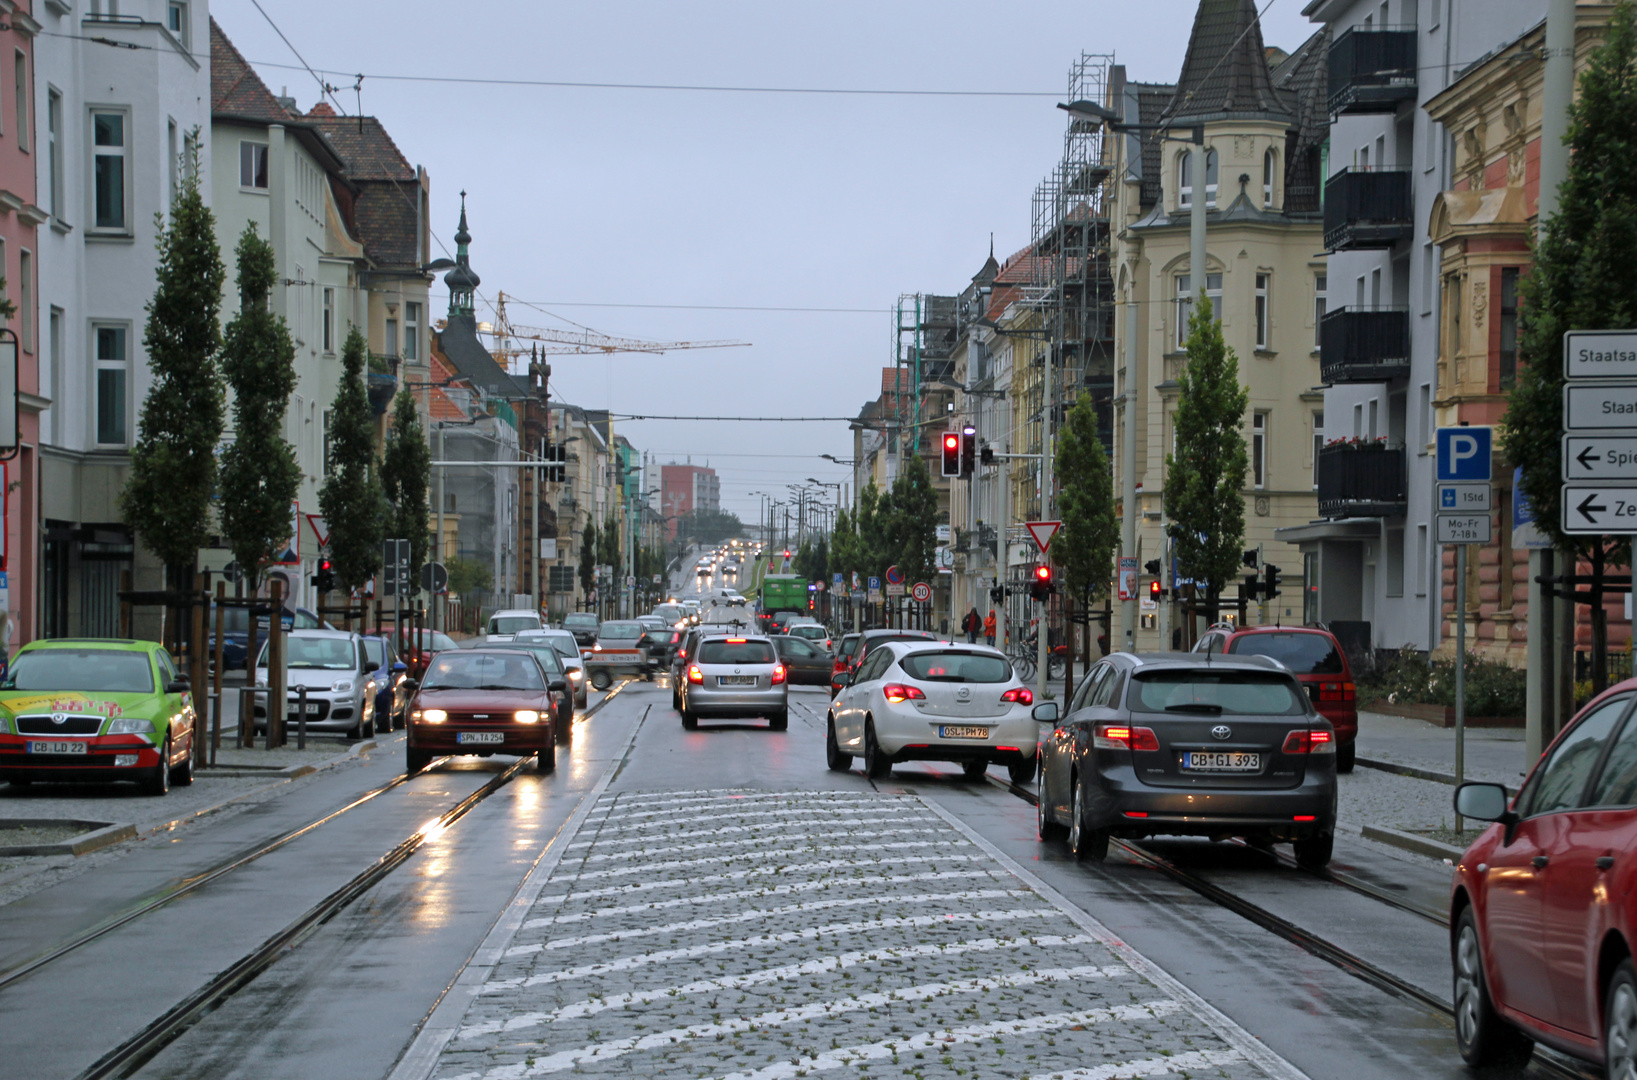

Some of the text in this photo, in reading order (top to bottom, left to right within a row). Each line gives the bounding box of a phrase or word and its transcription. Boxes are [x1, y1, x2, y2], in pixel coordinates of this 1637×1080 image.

[1449, 434, 1478, 474] P
[1614, 501, 1637, 517] Ze
[1448, 519, 1479, 528] Mo-Fr
[915, 587, 927, 597] 30
[945, 728, 988, 736] OSL PM 78
[34, 743, 84, 752] CB LD 22
[1191, 754, 1259, 767] CB GI 393
